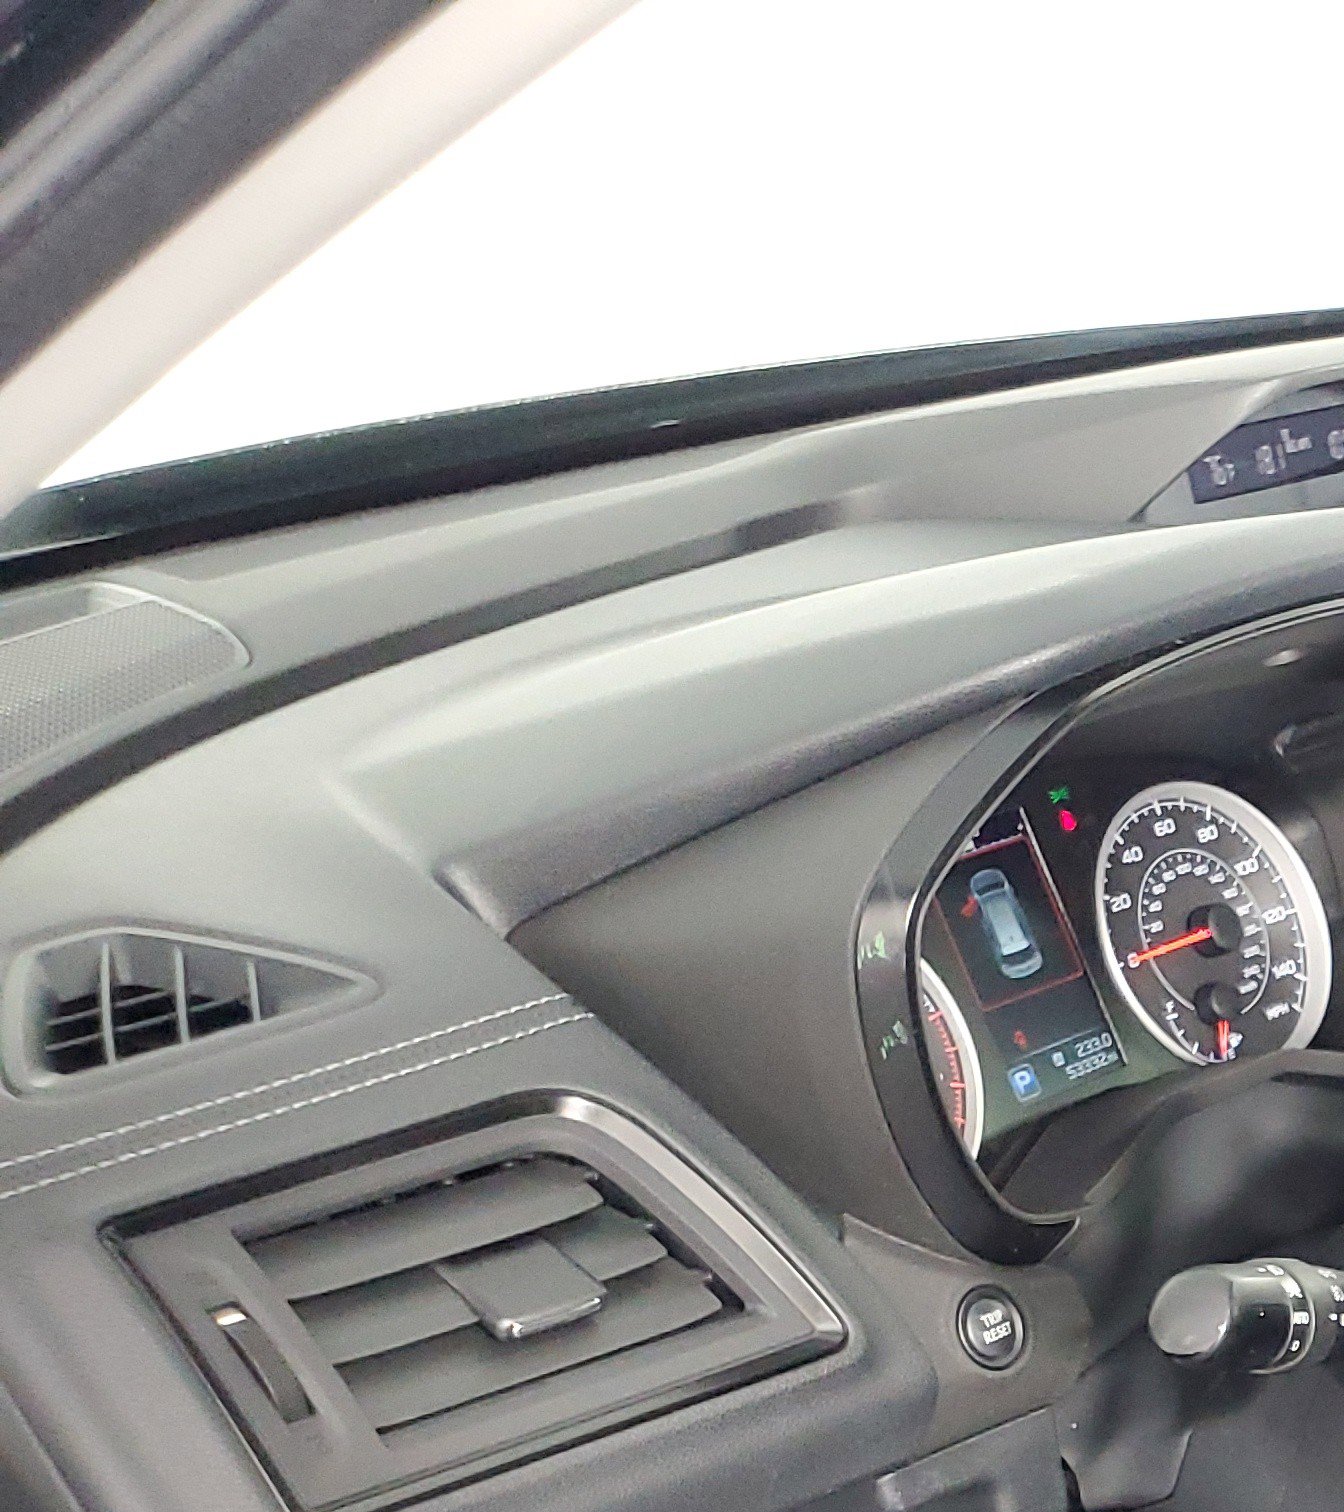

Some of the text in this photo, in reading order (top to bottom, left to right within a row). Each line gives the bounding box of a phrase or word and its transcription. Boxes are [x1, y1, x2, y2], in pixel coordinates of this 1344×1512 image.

[1154, 818, 1176, 837] 60
[1197, 823, 1219, 843] 80
[1122, 846, 1143, 864] 40
[1233, 857, 1260, 876] 100
[1110, 892, 1132, 913] 20
[1013, 1070, 1031, 1095] P
[980, 1309, 1003, 1328] TRIP
[982, 1321, 1012, 1345] RESET
